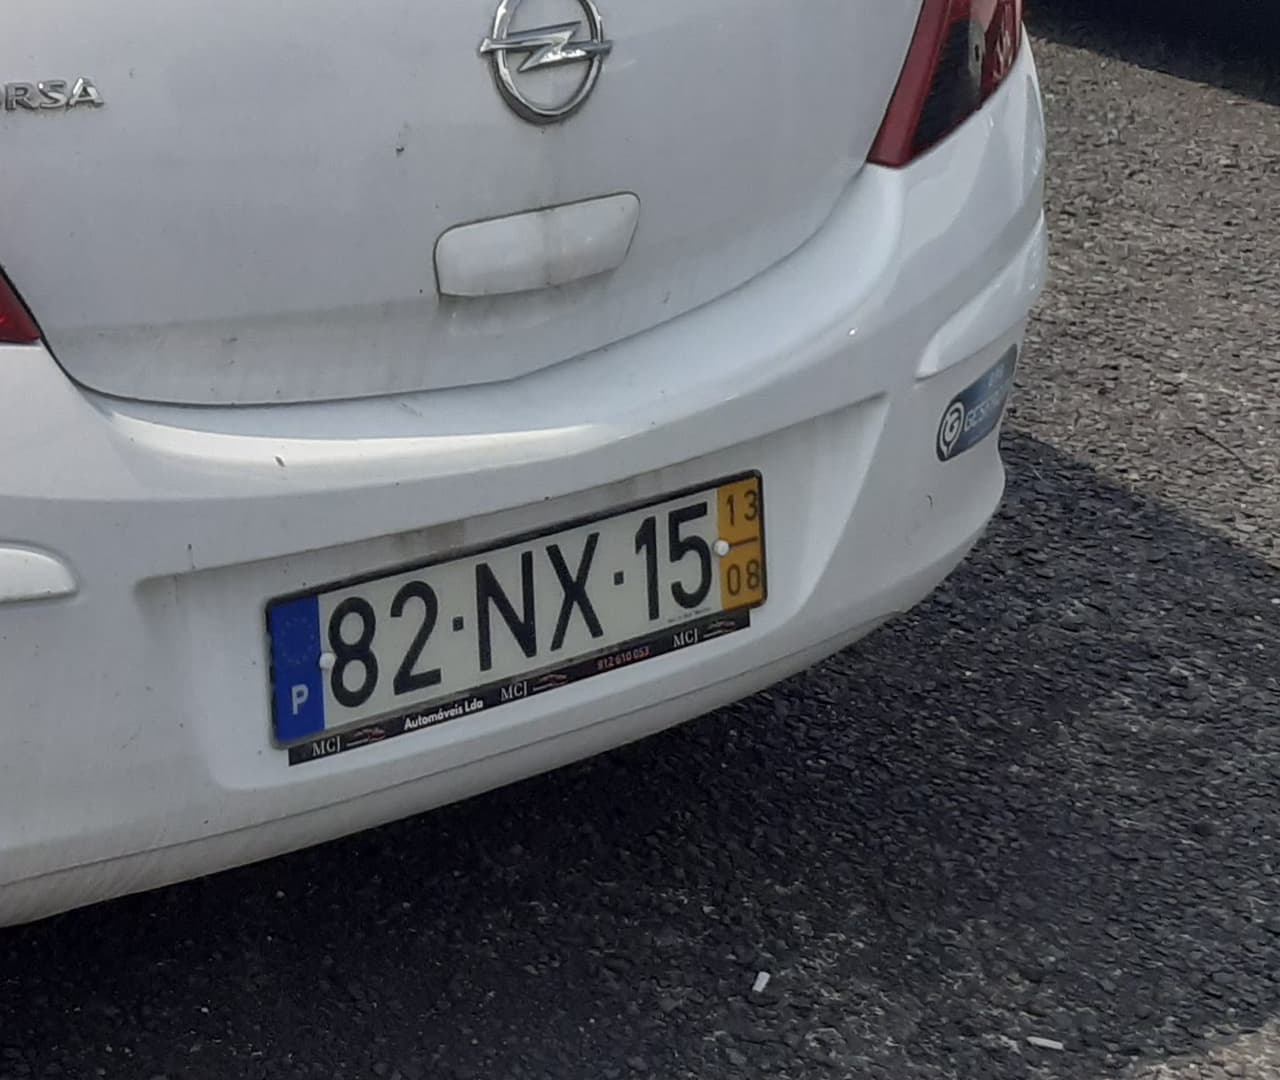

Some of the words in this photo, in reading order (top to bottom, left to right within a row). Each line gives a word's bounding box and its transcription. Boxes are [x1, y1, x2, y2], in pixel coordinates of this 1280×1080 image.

[727, 489, 758, 526] 13
[727, 559, 760, 596] 08
[291, 683, 309, 715] P
[312, 735, 340, 757] MCJ
[404, 704, 463, 730] Automóveis
[465, 698, 484, 713] Lda
[500, 680, 528, 702] MCJ
[672, 628, 699, 648] MCJ
